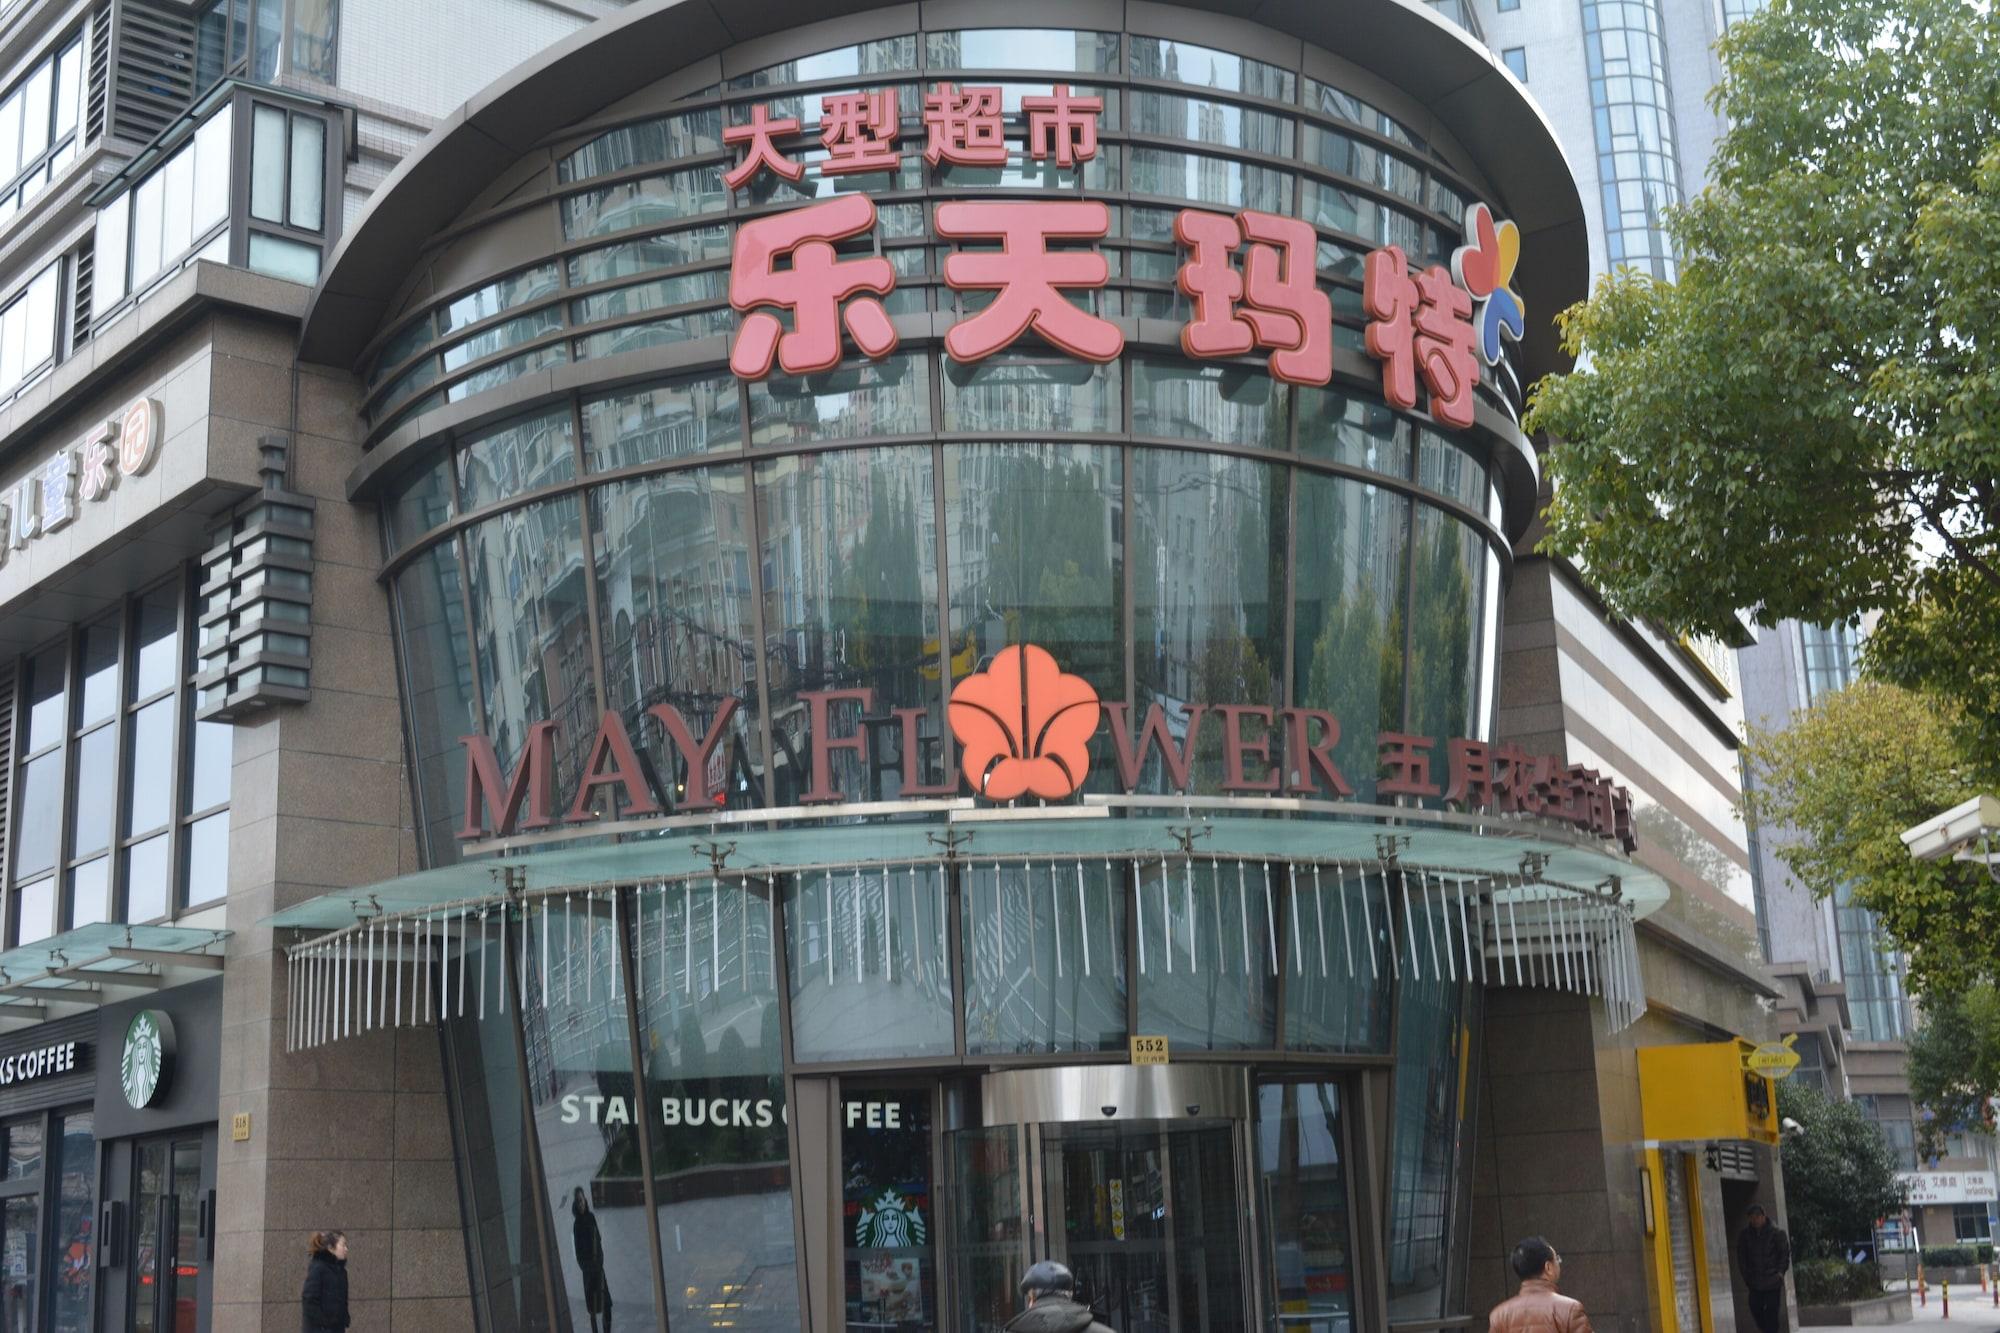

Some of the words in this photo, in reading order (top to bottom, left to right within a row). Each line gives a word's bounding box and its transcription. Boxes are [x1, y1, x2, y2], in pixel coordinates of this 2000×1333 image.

[721, 81, 1103, 190] 大型超市
[728, 192, 1481, 430] 乐天玛特
[17, 1041, 75, 1081] COFFEE
[1136, 1039, 1164, 1052] 552
